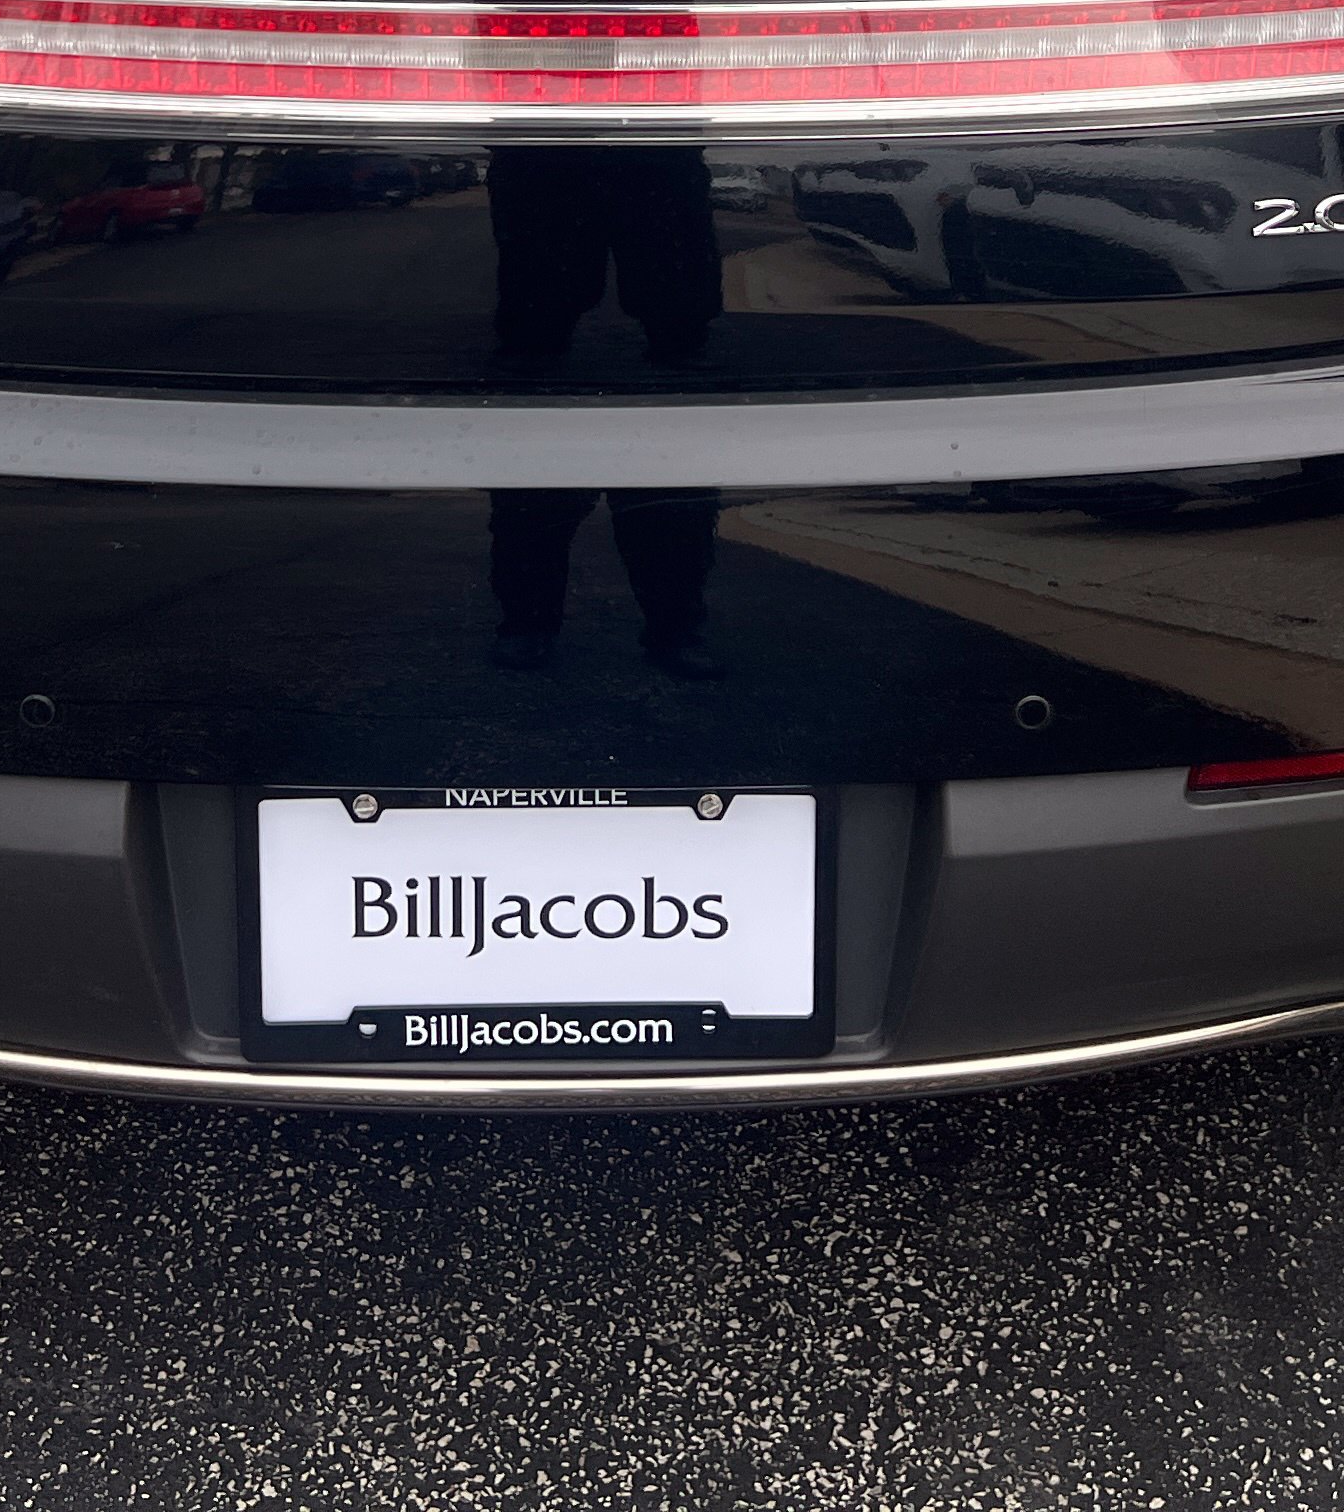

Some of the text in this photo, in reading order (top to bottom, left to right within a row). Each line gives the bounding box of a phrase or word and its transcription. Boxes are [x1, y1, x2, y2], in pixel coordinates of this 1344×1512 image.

[444, 788, 629, 807] NAPERVILLE
[352, 875, 729, 957] BillJacobs
[404, 1013, 674, 1054] BillJacobs.com
